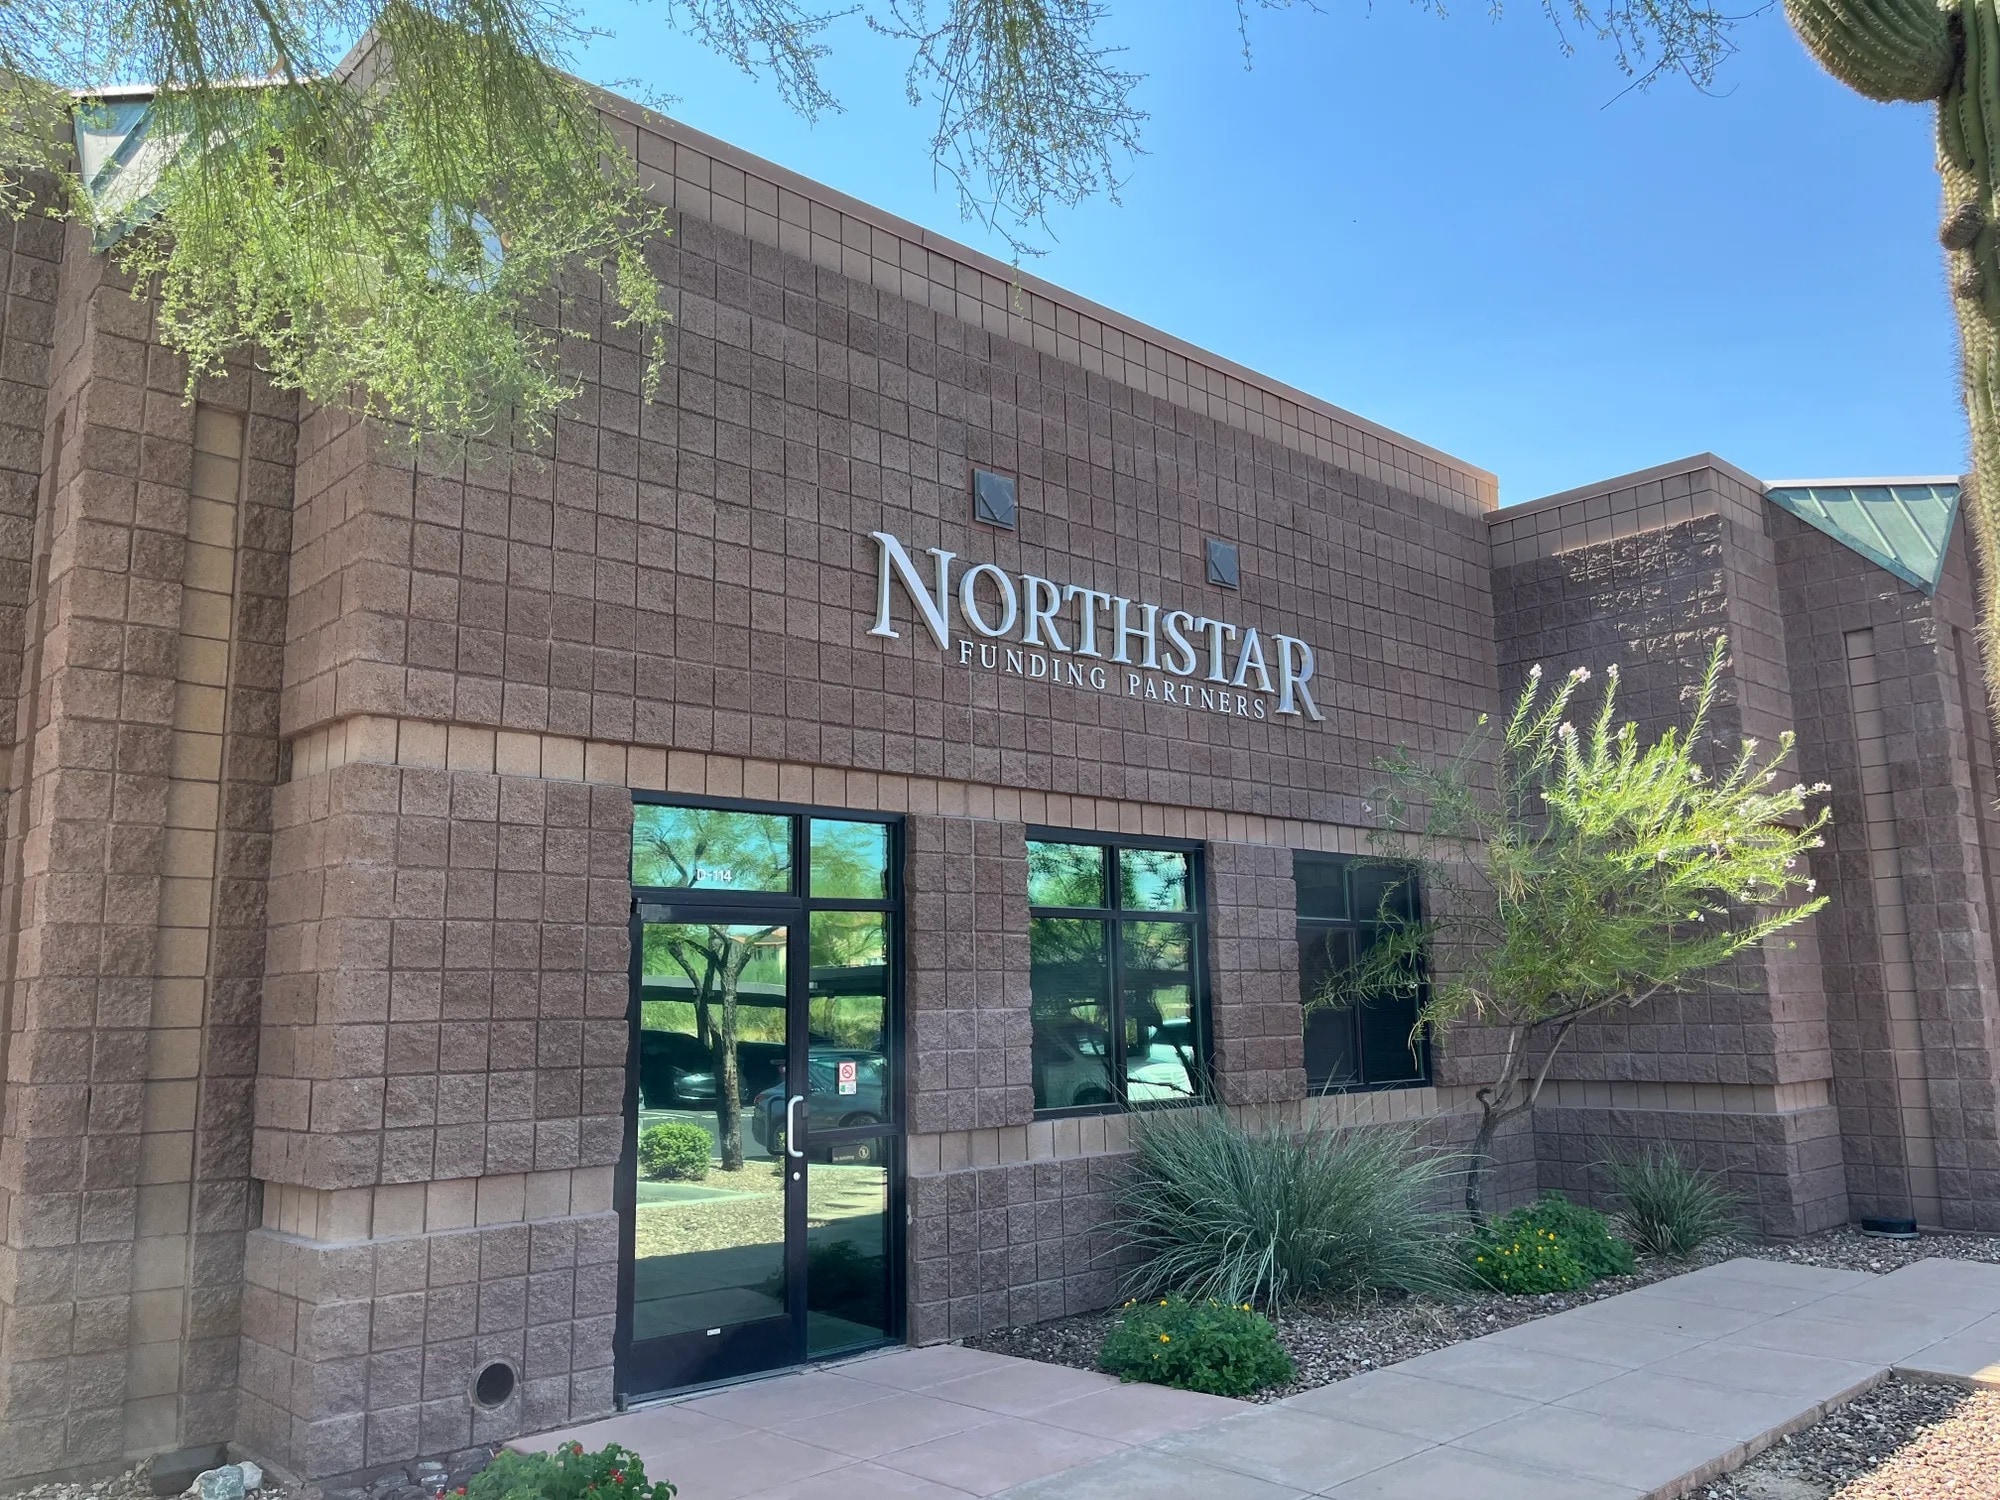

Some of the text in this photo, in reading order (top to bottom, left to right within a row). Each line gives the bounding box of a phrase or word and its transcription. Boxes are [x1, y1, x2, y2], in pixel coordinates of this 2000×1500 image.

[867, 531, 1326, 721] NORTHSTAR
[959, 639, 1265, 719] FUNDING PARTNERS
[696, 869, 732, 881] D-114
